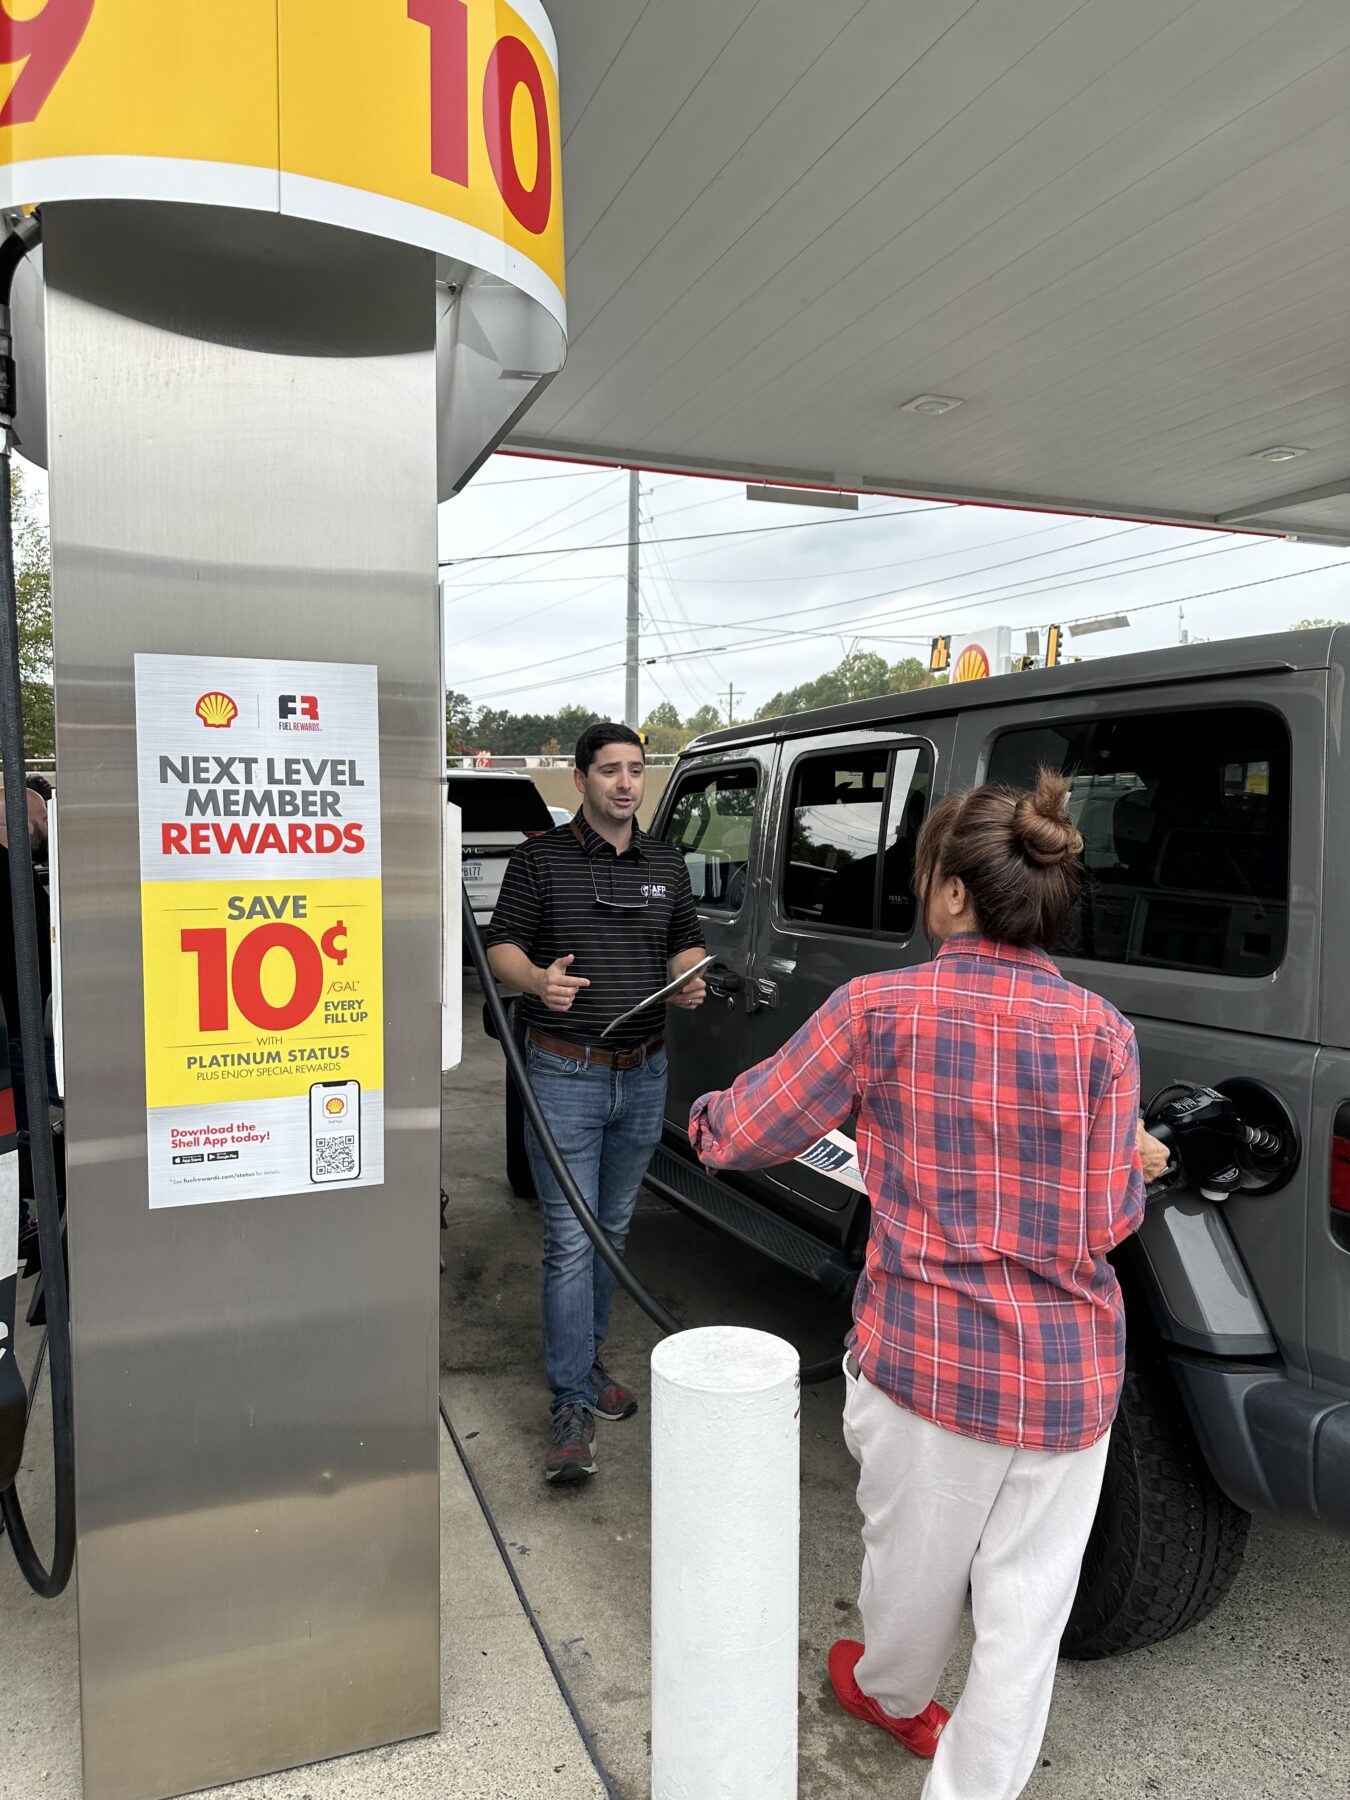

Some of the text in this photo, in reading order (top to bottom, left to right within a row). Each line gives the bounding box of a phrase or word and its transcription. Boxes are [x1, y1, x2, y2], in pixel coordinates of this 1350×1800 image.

[0, 0, 95, 127] 9
[407, 0, 552, 235] 10
[279, 722, 319, 731] FUEL REWARDS
[159, 756, 364, 786] NEXT LEVEL
[185, 788, 343, 817] MEMBER
[161, 822, 365, 855] REWARDS
[462, 866, 481, 877] B177
[652, 884, 666, 893] AFP
[227, 895, 307, 920] SAVE
[324, 999, 364, 1011] EVERY
[324, 1012, 368, 1024] FILL UP
[256, 1036, 283, 1046] WITH
[187, 1046, 350, 1069] PLATINUM STATUS
[196, 1062, 341, 1081] PLUS ENJOY SPECIAL REWARDS
[171, 1122, 256, 1138] Download the
[171, 1131, 270, 1148] Shell App today!
